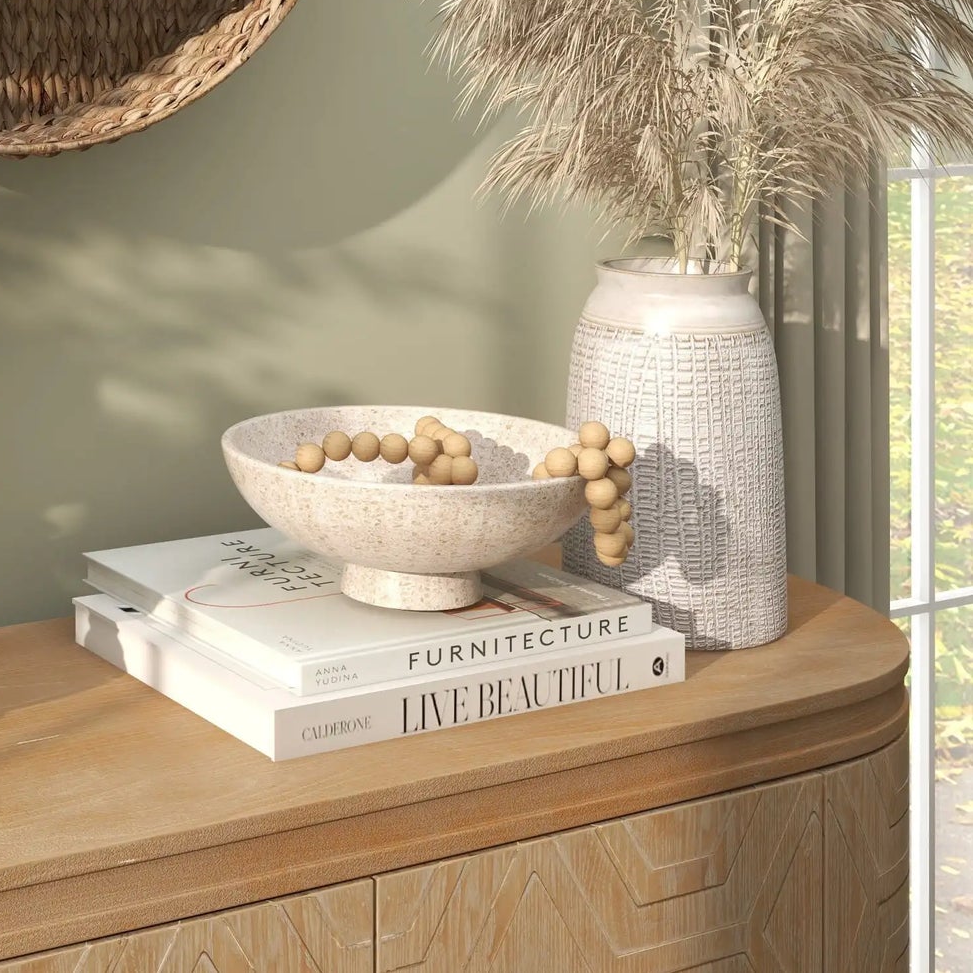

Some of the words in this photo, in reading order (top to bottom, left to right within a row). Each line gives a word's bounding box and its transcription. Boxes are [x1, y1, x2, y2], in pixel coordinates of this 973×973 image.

[220, 556, 308, 592] FURNI
[221, 539, 335, 588] TECTURE
[408, 615, 630, 671] FURNITECTURE
[315, 664, 347, 677] ANNA
[315, 672, 359, 688] YUDINA
[301, 715, 372, 743] CALDERONE
[400, 687, 470, 735] LIVE
[478, 657, 630, 719] BEAUTIFUL
